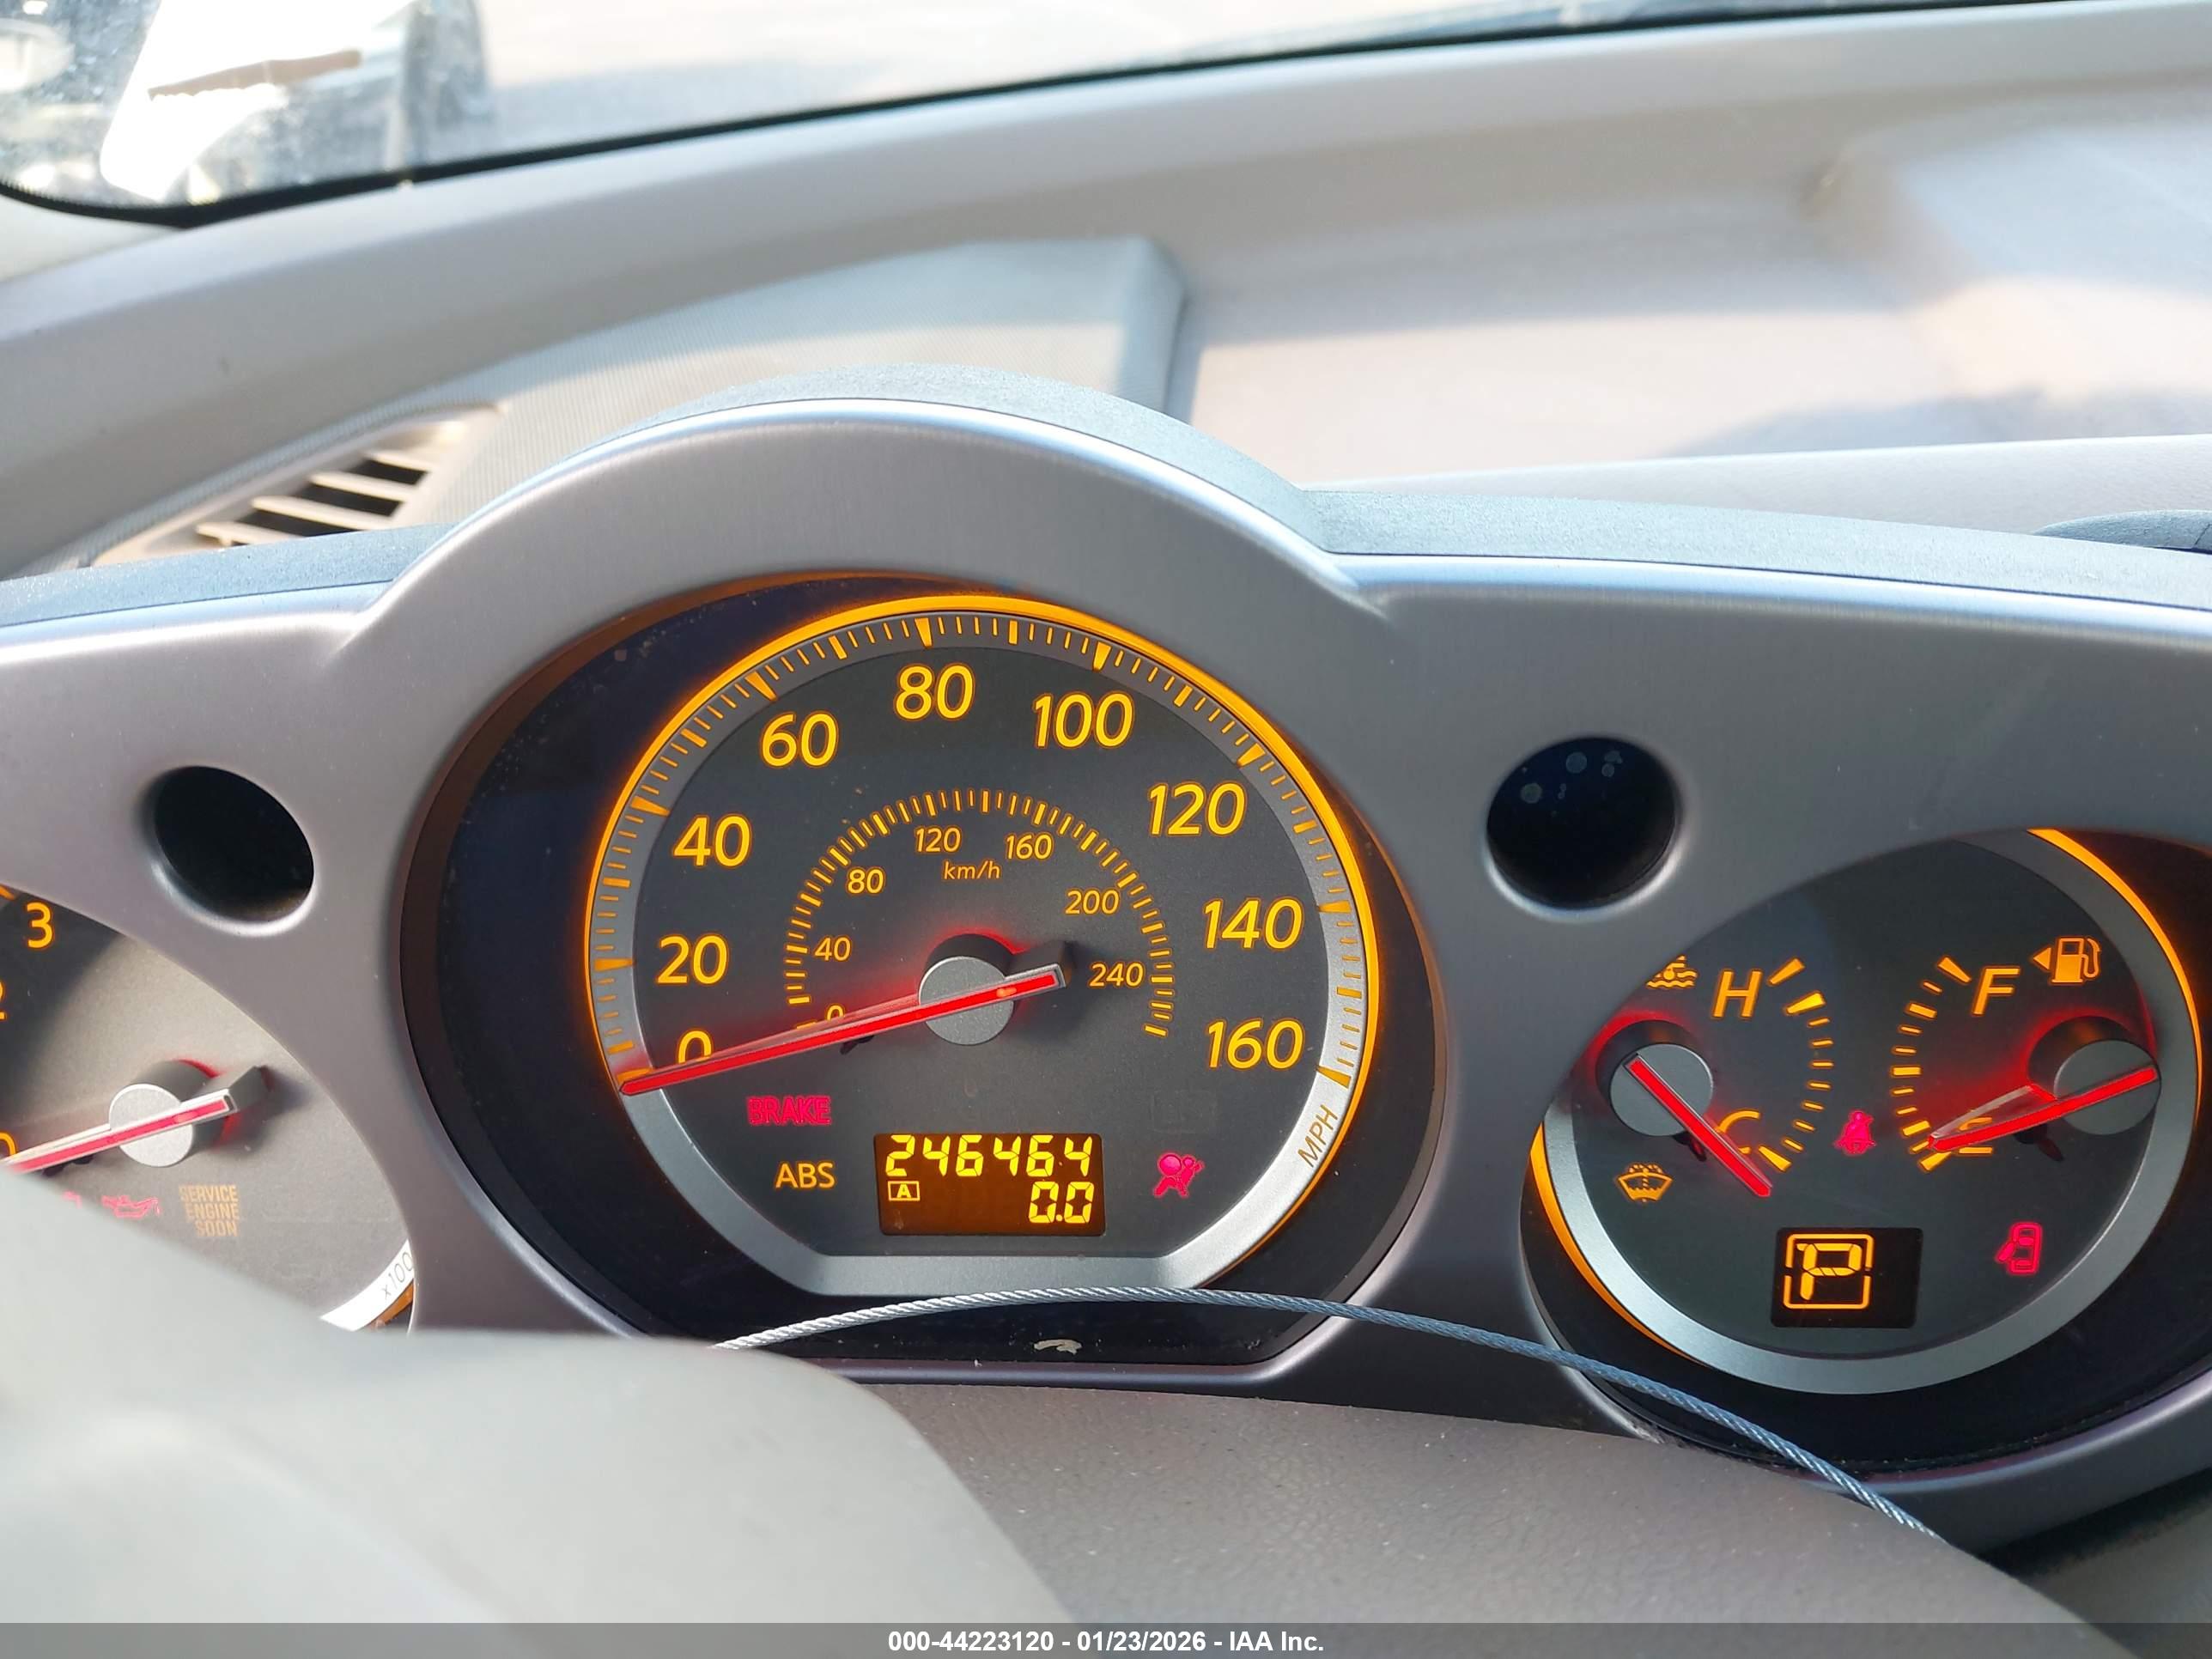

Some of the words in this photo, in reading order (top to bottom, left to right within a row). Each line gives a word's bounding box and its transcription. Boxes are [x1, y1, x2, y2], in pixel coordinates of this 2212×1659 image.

[896, 665, 974, 720] 80
[762, 713, 838, 766] 60
[1036, 692, 1133, 748] 100
[1149, 782, 1245, 836] 120
[674, 815, 750, 866] 40
[916, 827, 961, 853] 120
[1006, 832, 1053, 859] 160
[848, 869, 885, 894] 80
[944, 860, 1000, 879] km/h
[1066, 889, 1120, 915] 200
[1205, 898, 1303, 949] 140
[27, 902, 52, 948] 3
[657, 935, 727, 984] 20
[815, 937, 851, 961] 40
[1090, 962, 1143, 987] 240
[1713, 970, 1762, 1018] H
[1972, 967, 2021, 1015] F
[678, 1030, 712, 1064] 0
[1209, 1020, 1304, 1069] 160
[747, 1096, 831, 1125] BRAKE
[885, 1134, 1092, 1177] 246464
[1297, 1104, 1339, 1168] MPH
[179, 1184, 239, 1201] SERVICE
[775, 1162, 836, 1189] ABS
[186, 1203, 239, 1219] ENGINE
[1028, 1181, 1094, 1224] 0.0
[197, 1220, 238, 1237] SOON
[1796, 1243, 1863, 1301] P
